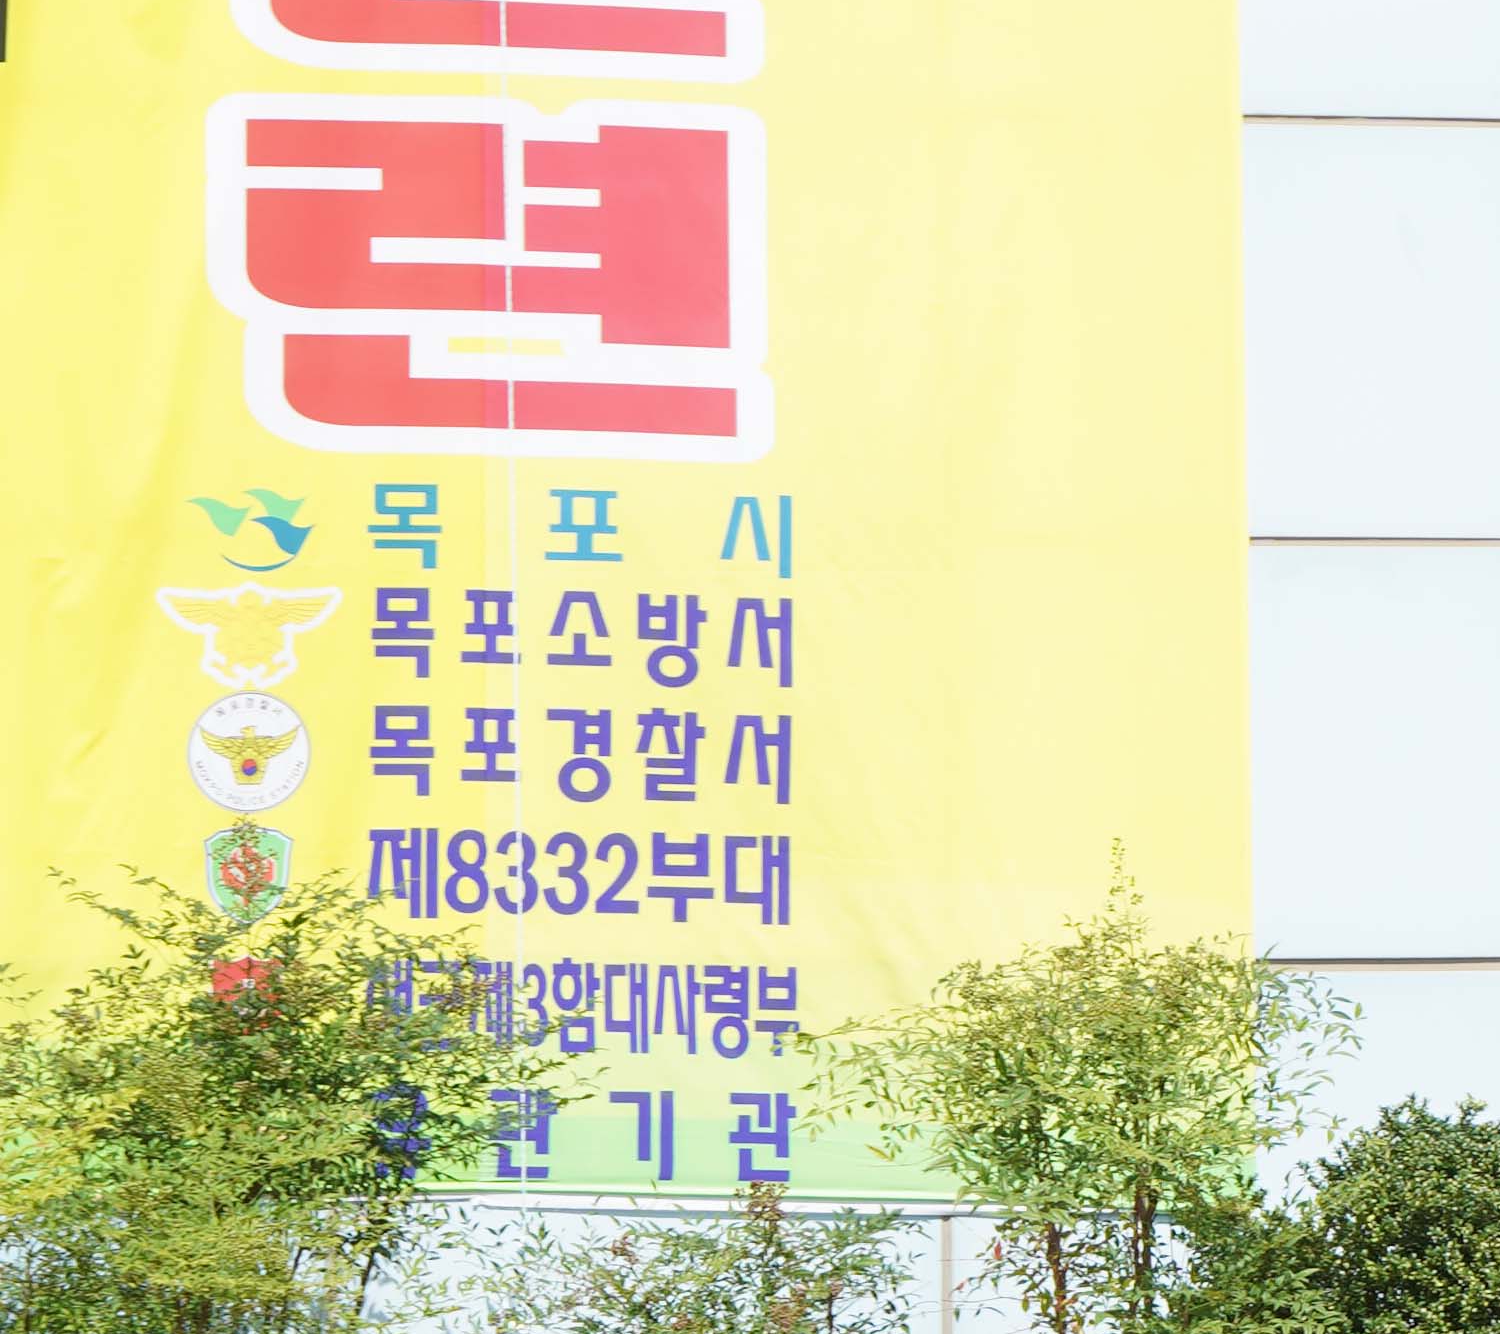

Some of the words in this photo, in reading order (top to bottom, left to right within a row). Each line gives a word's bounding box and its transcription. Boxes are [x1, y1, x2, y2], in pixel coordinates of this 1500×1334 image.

[370, 586, 793, 689] 목포소방서
[369, 704, 793, 805] 목포경찰서
[366, 827, 792, 925] 제8332부대
